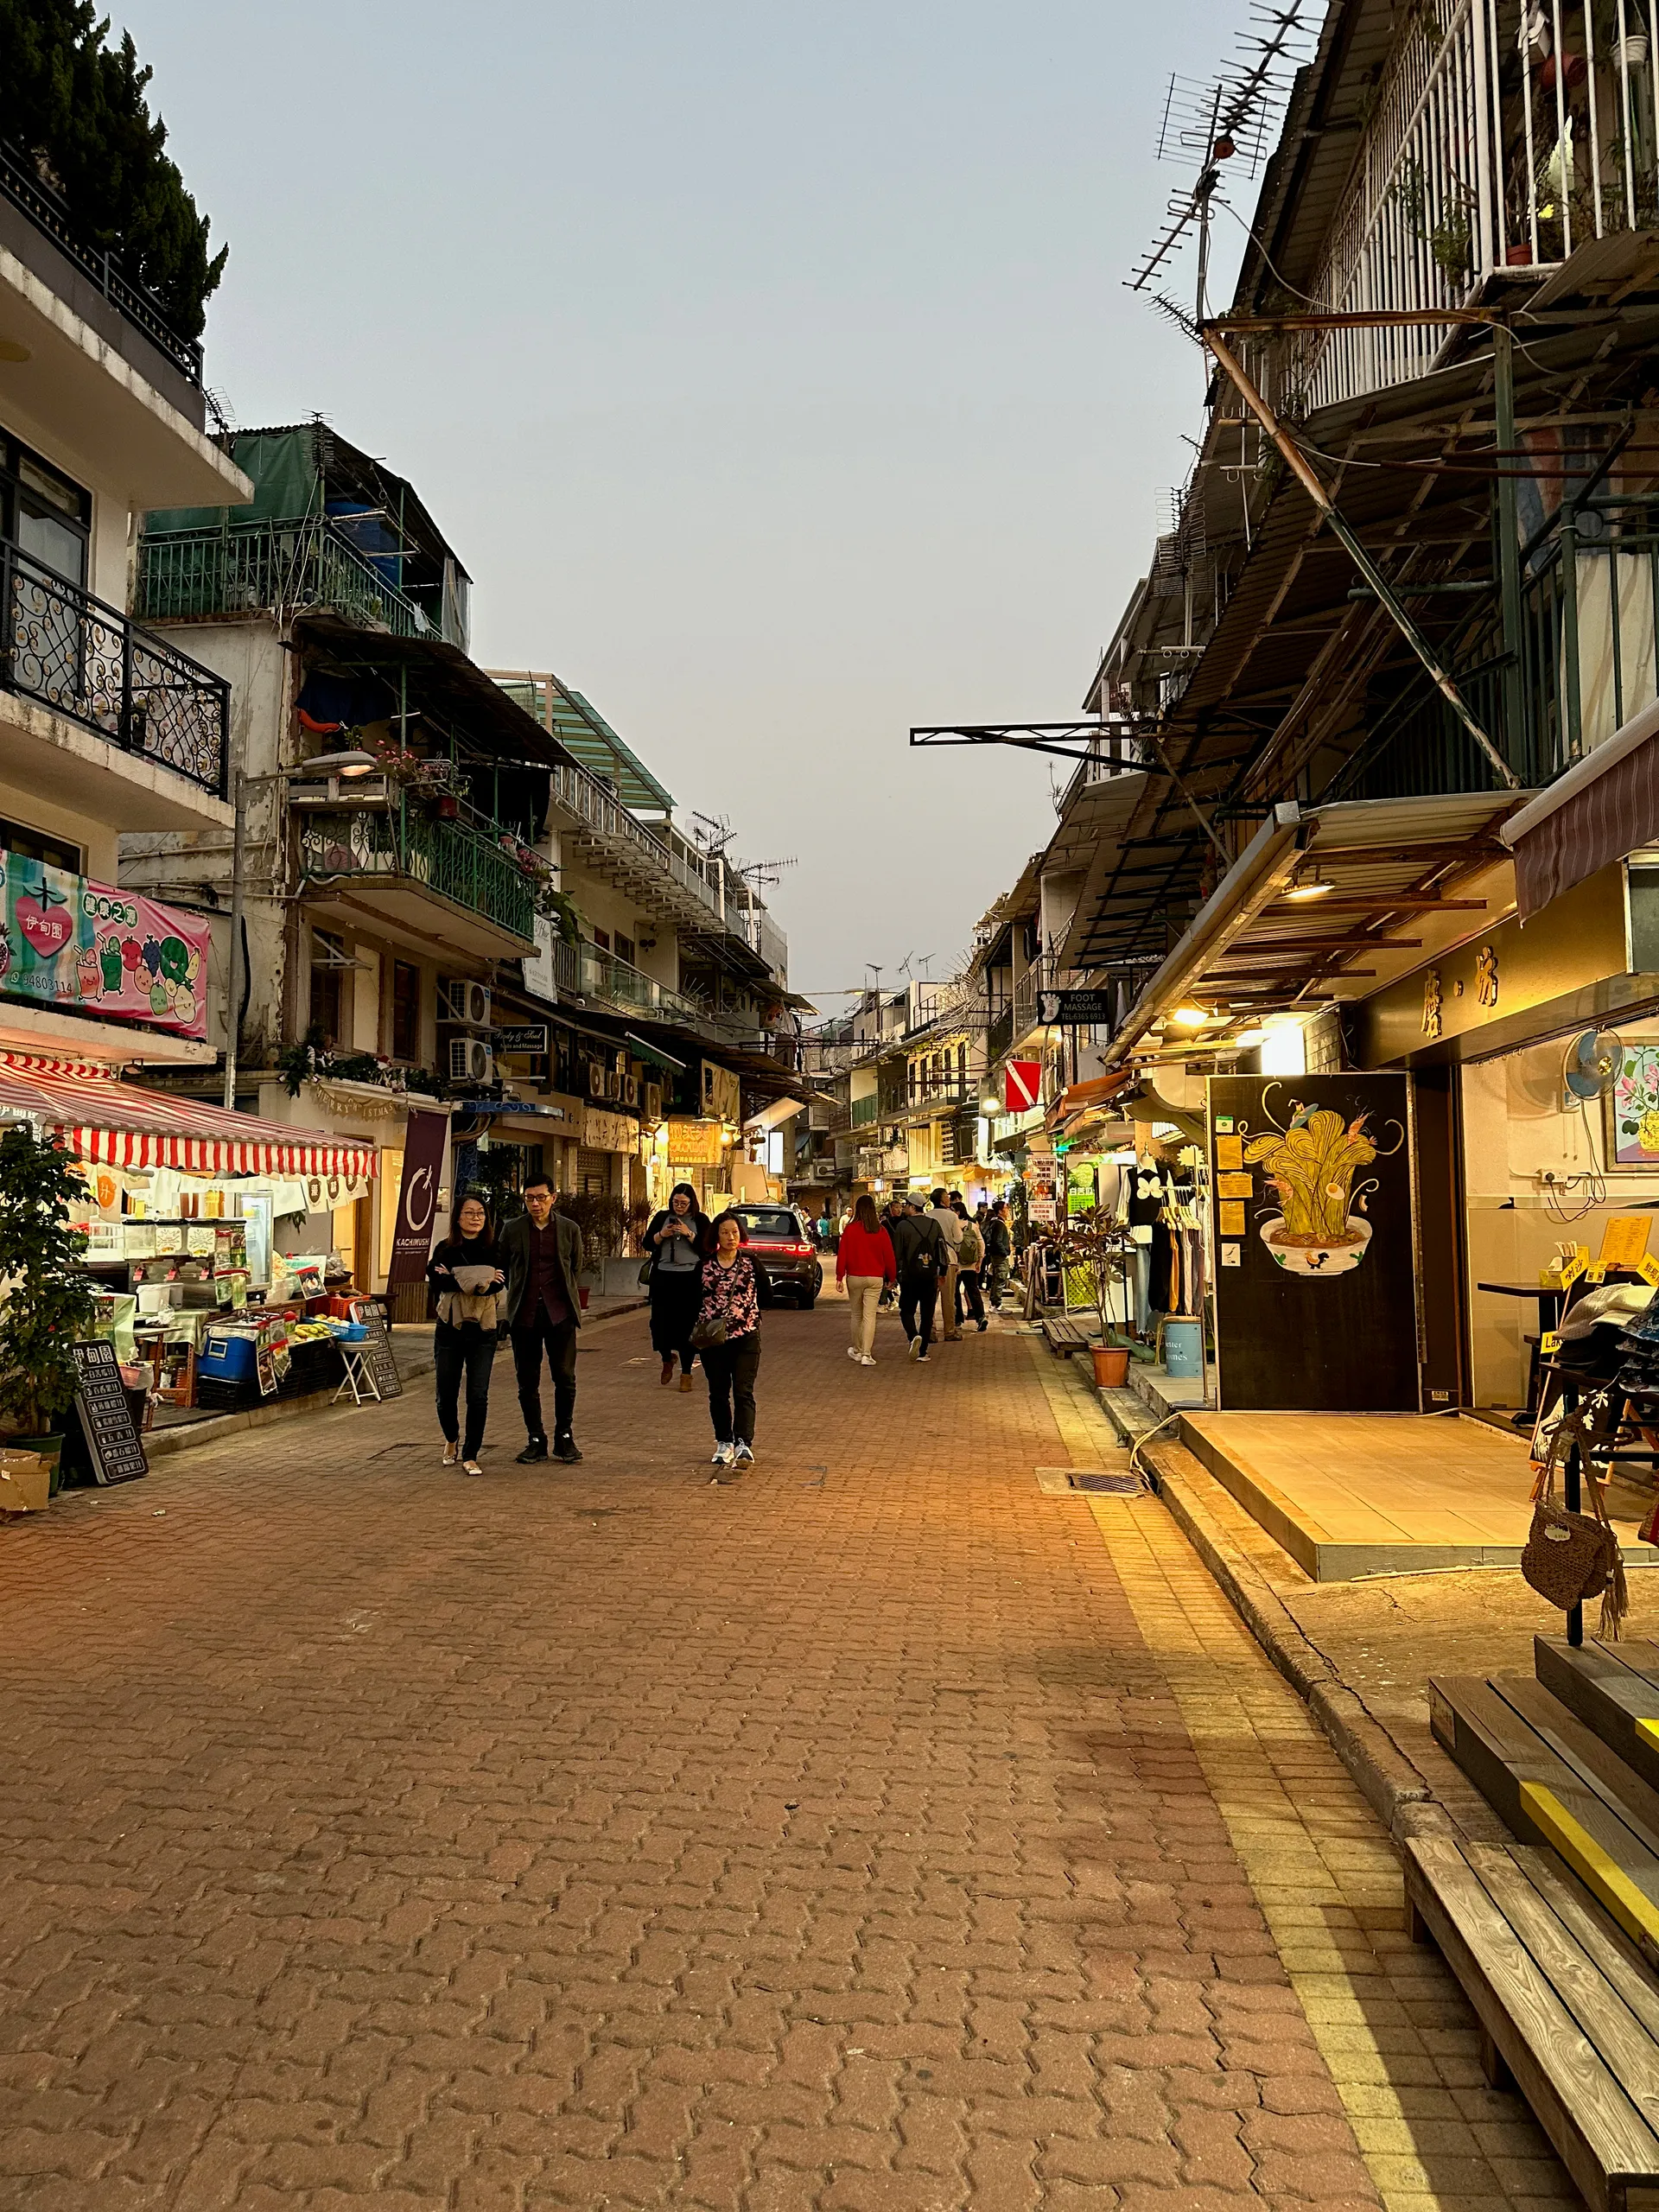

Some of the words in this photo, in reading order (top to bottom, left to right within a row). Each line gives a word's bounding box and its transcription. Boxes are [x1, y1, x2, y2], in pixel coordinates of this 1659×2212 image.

[85, 895, 137, 926] 健康之源
[26, 914, 63, 939] 伊甸園
[22, 973, 73, 993] 94803114
[1064, 1002, 1103, 1011] MASSAGE
[1071, 994, 1096, 1002] FOOT
[515, 1031, 523, 1043] &
[524, 1029, 543, 1039] Soul
[316, 1086, 350, 1114] MERRY
[396, 1237, 430, 1247] KACHIMUSHI
